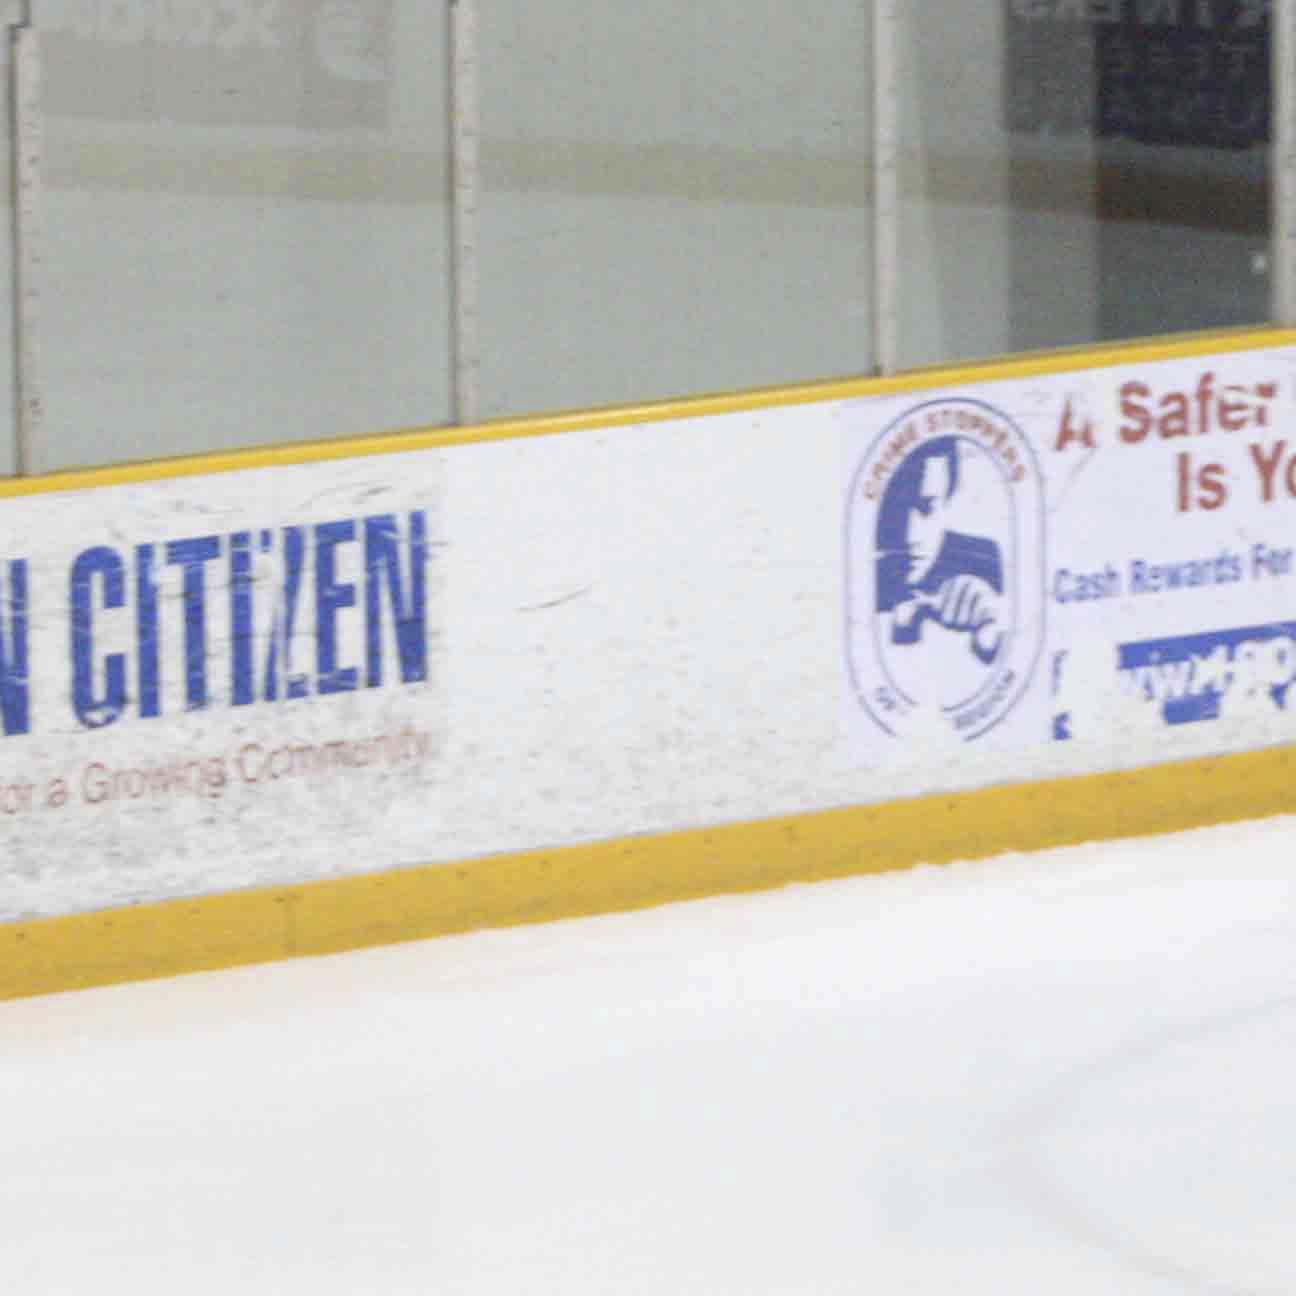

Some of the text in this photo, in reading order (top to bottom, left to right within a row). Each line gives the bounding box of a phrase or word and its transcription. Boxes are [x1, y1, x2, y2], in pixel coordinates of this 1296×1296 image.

[1119, 371, 1278, 443] Safer
[928, 409, 1025, 481] STOPPERS
[1177, 452, 1227, 512] Is
[1055, 568, 1121, 604] Cash
[1130, 557, 1241, 594] Rewards
[69, 509, 427, 729] CITIZEN
[49, 778, 69, 807] a
[83, 756, 227, 805] Growing
[240, 727, 432, 784] Community
